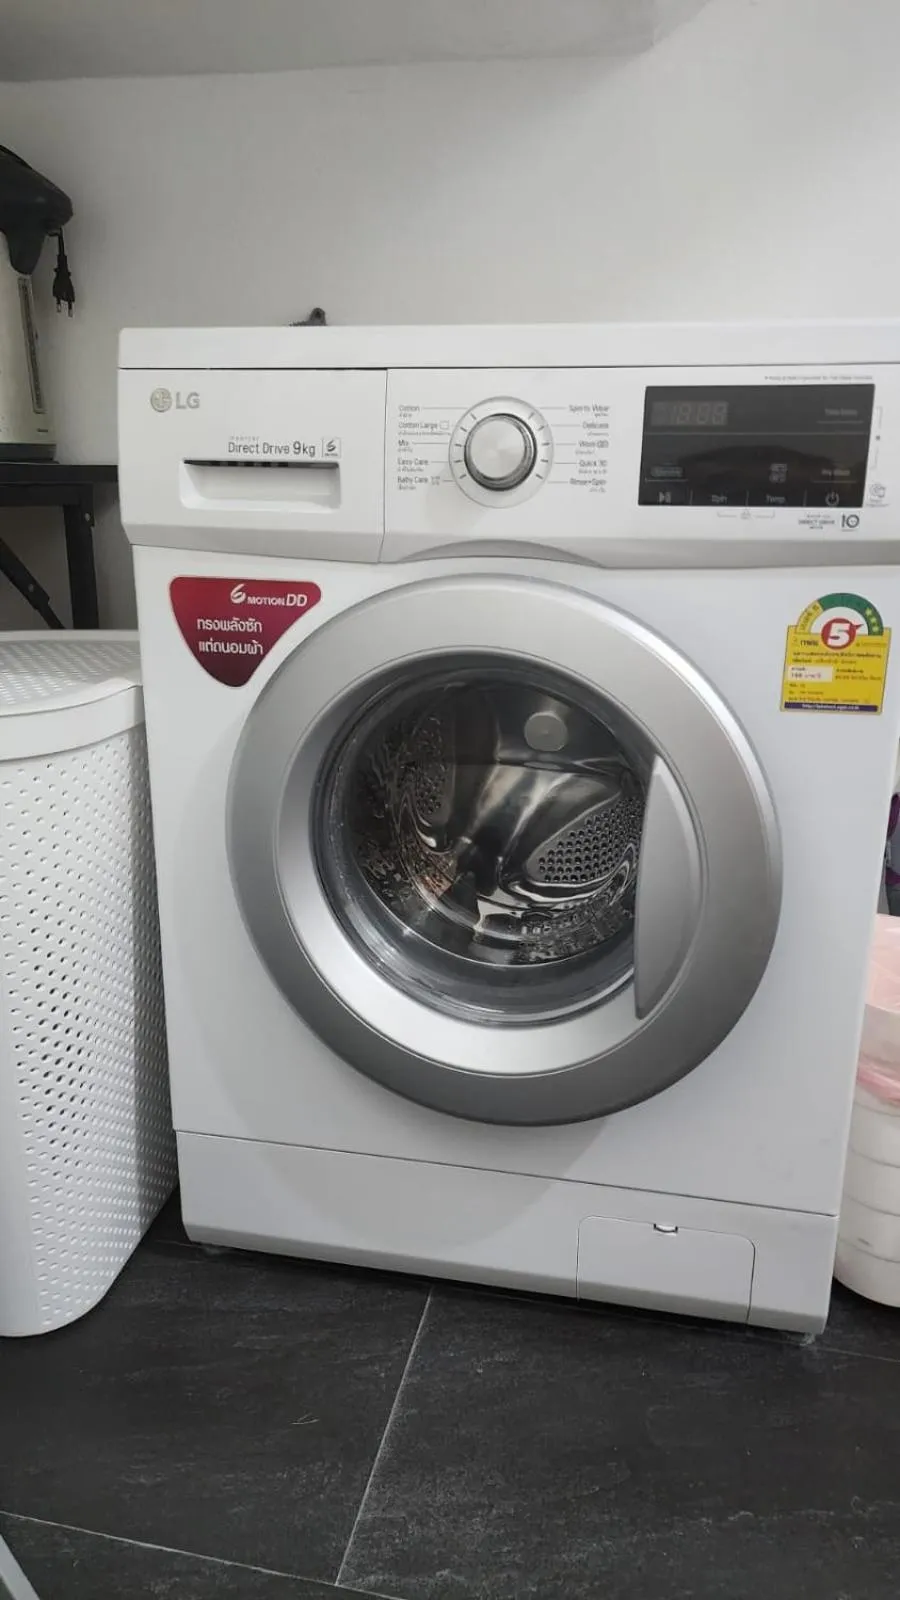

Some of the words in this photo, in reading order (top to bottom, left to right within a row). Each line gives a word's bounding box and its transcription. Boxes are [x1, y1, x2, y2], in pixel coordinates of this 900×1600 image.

[175, 391, 200, 410] LG
[228, 441, 259, 454] Direct
[263, 442, 290, 455] Drive
[247, 596, 286, 607] MOTION
[286, 593, 308, 607] DD
[826, 622, 851, 647] 5
[198, 637, 264, 656] แต่ถนอมผ้า
